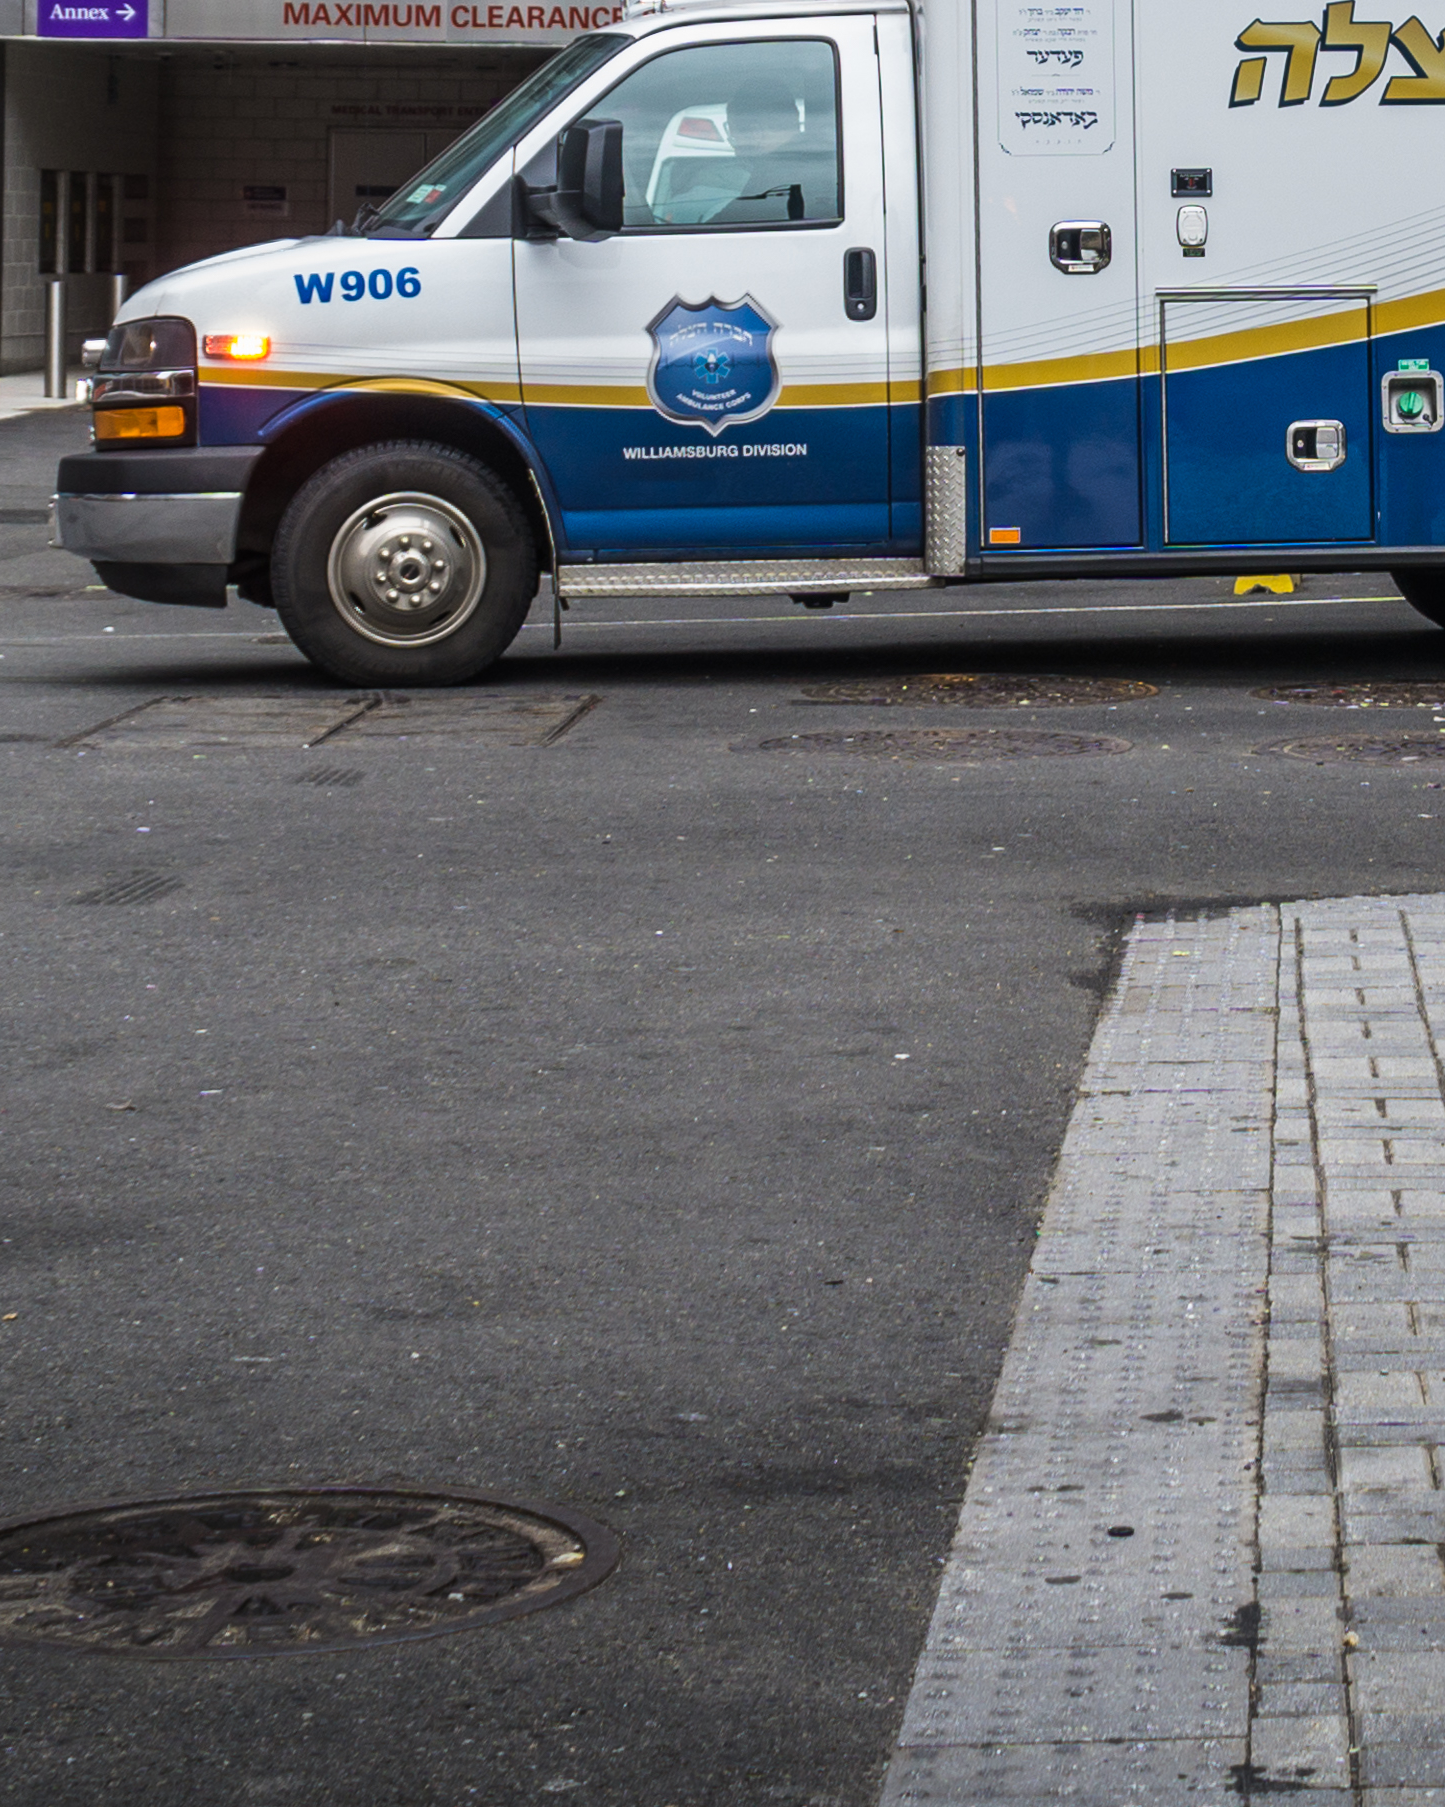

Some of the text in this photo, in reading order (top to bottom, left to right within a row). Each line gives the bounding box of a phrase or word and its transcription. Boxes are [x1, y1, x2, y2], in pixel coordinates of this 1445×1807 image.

[49, 3, 109, 21] Annex
[282, 1, 442, 28] MAXIMUM
[332, 104, 382, 115] MEDICAL
[293, 266, 422, 304] W906
[676, 392, 752, 410] AMBULANCE CORPS
[692, 389, 736, 400] VOLUNTEER
[623, 443, 807, 460] WILLIAMSBURG DIVISION
